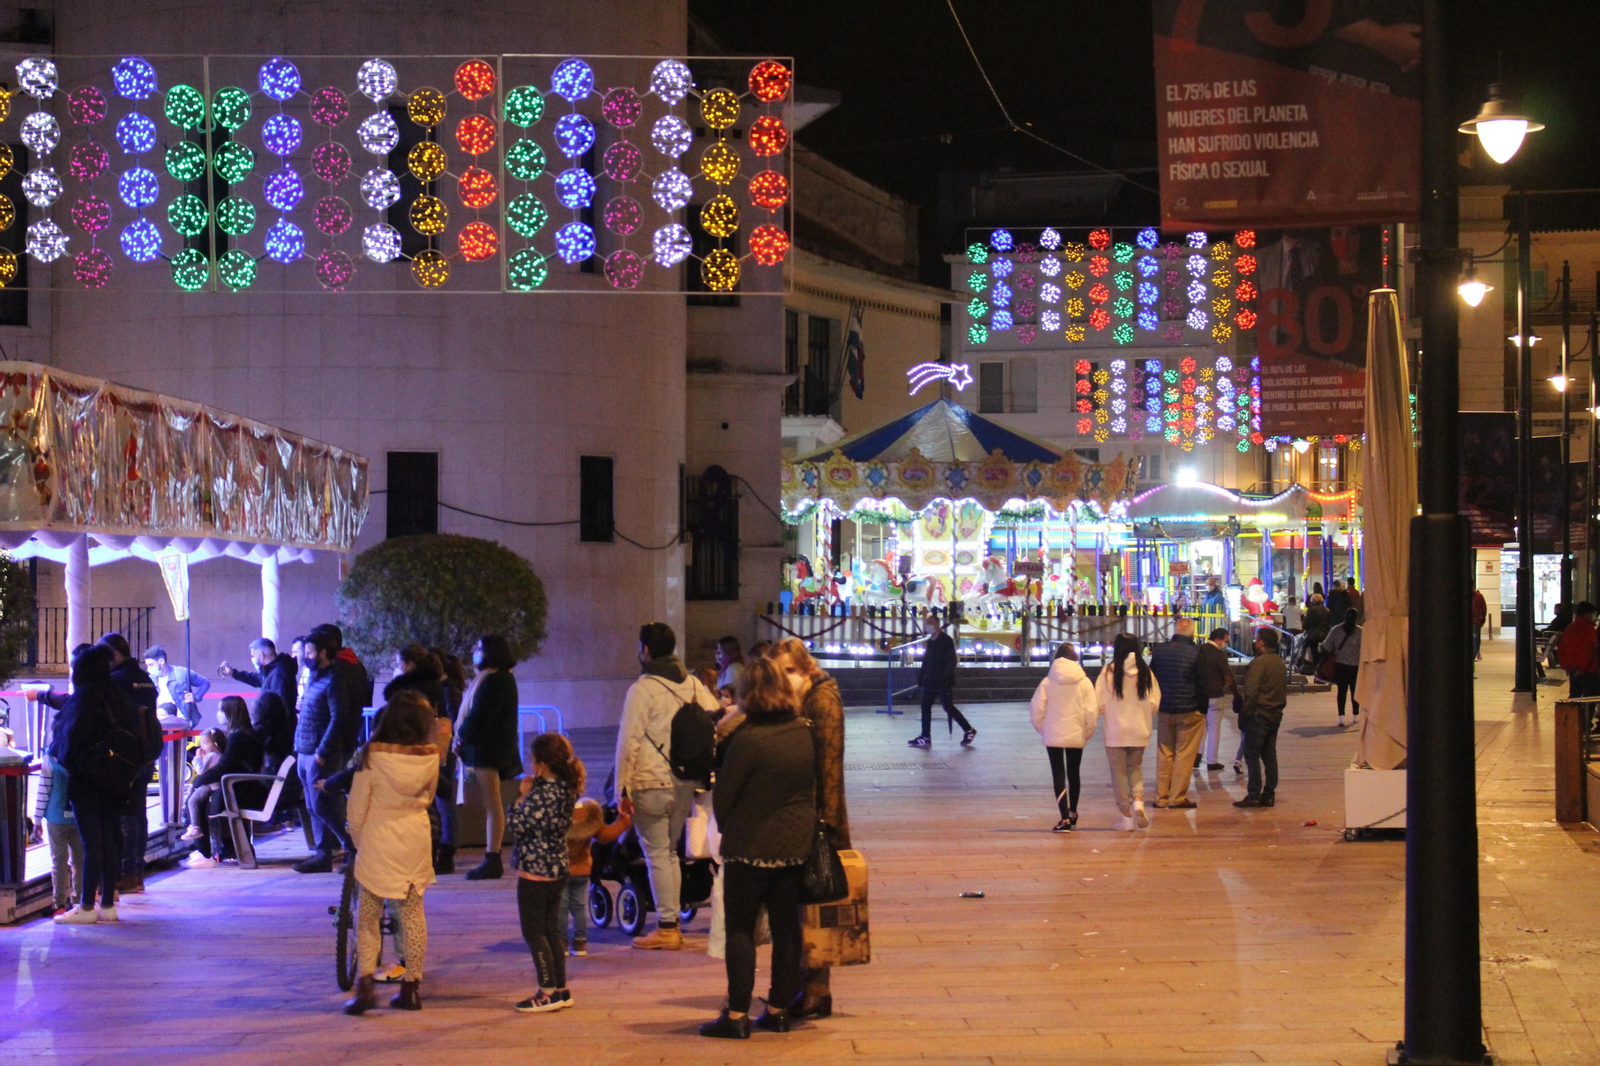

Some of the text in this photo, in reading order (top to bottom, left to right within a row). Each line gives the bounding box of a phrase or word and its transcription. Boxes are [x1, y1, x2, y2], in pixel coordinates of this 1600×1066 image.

[1166, 80, 1256, 101] EL 75% DE LAS
[1167, 105, 1308, 128] MUJERES DEL PLANETA
[1168, 131, 1319, 154] HAN SUFRIDO VIOLENCIA
[1169, 159, 1270, 181] FÍSICA O SEXUAL
[1262, 365, 1306, 374] EL 80% DE LAS
[1262, 376, 1342, 386] VIOLACIONES SE PRODUCEN
[1262, 388, 1366, 399] DENTRO DE LOS ENTORNOS DE RELA
[1262, 403, 1271, 412] DE
[1297, 402, 1330, 410] AMISTADES
[1339, 401, 1363, 409] FAMILIA
